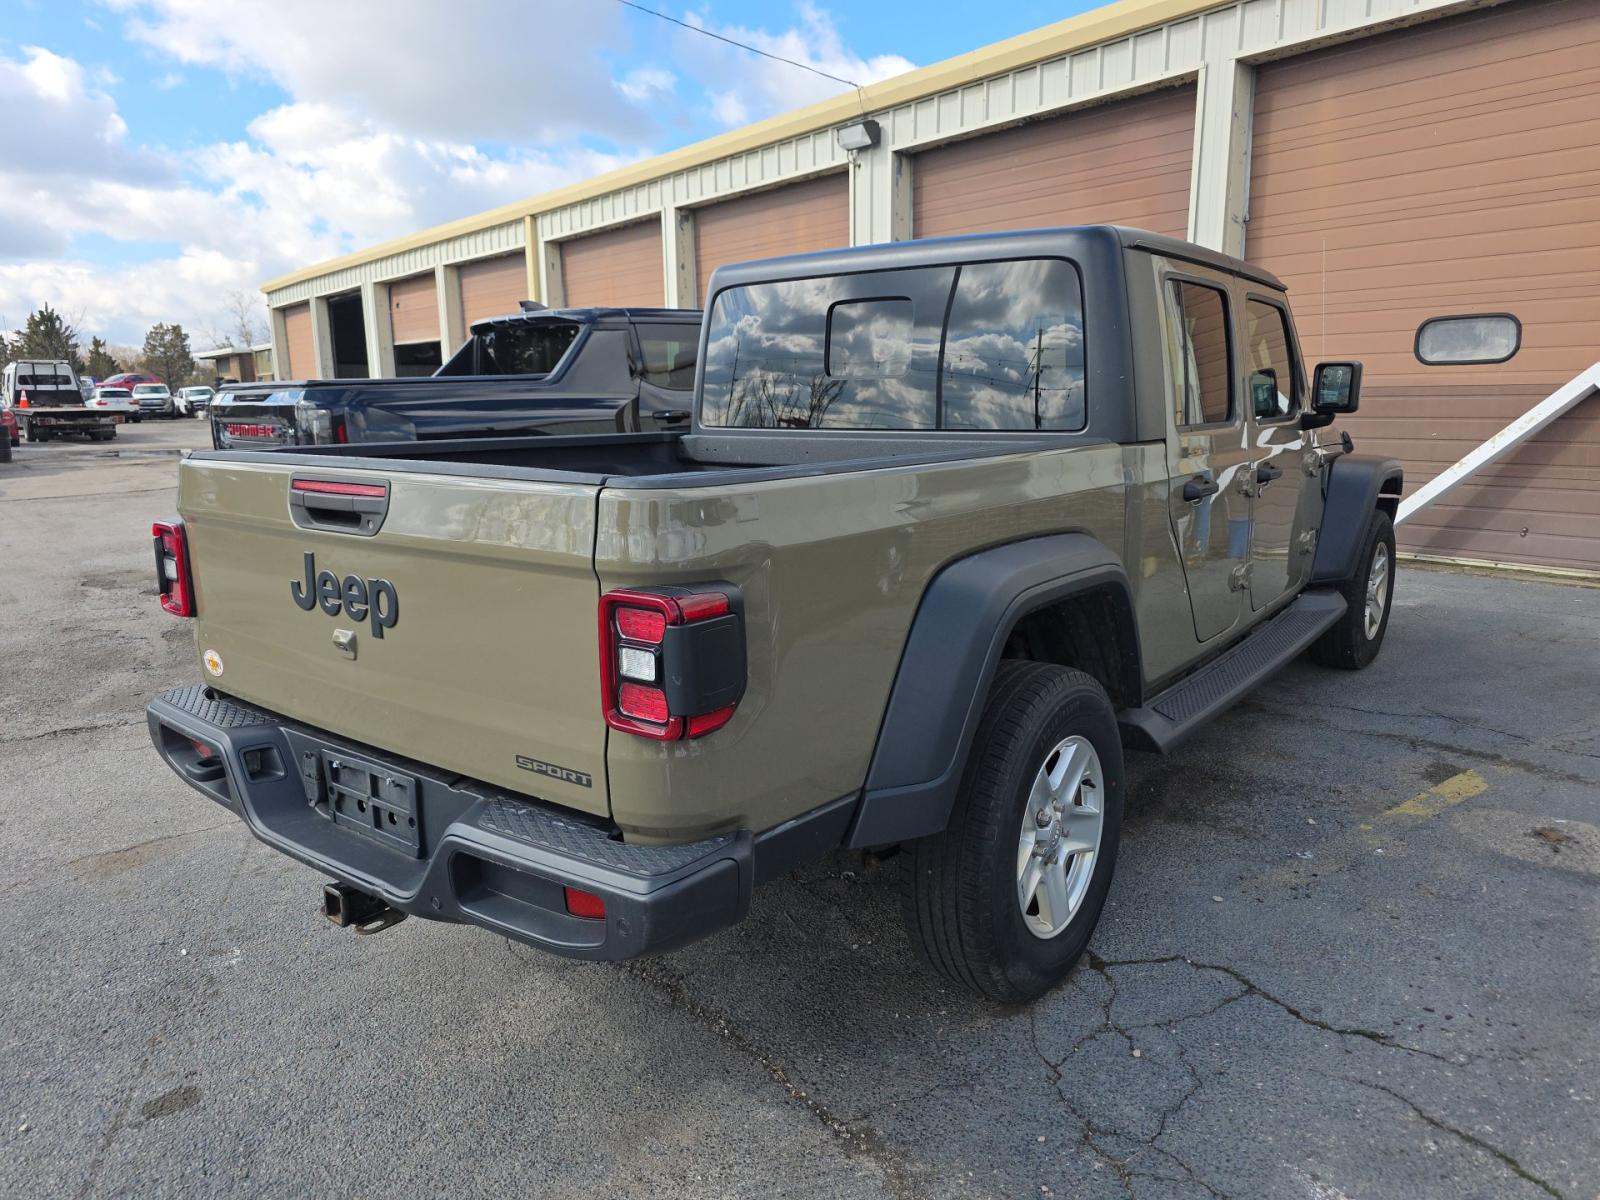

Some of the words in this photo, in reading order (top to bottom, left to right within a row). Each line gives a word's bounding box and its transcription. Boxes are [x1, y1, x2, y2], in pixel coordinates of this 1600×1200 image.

[226, 423, 274, 438] HUMMER
[290, 551, 399, 639] Jeep
[517, 756, 591, 786] SPORT
